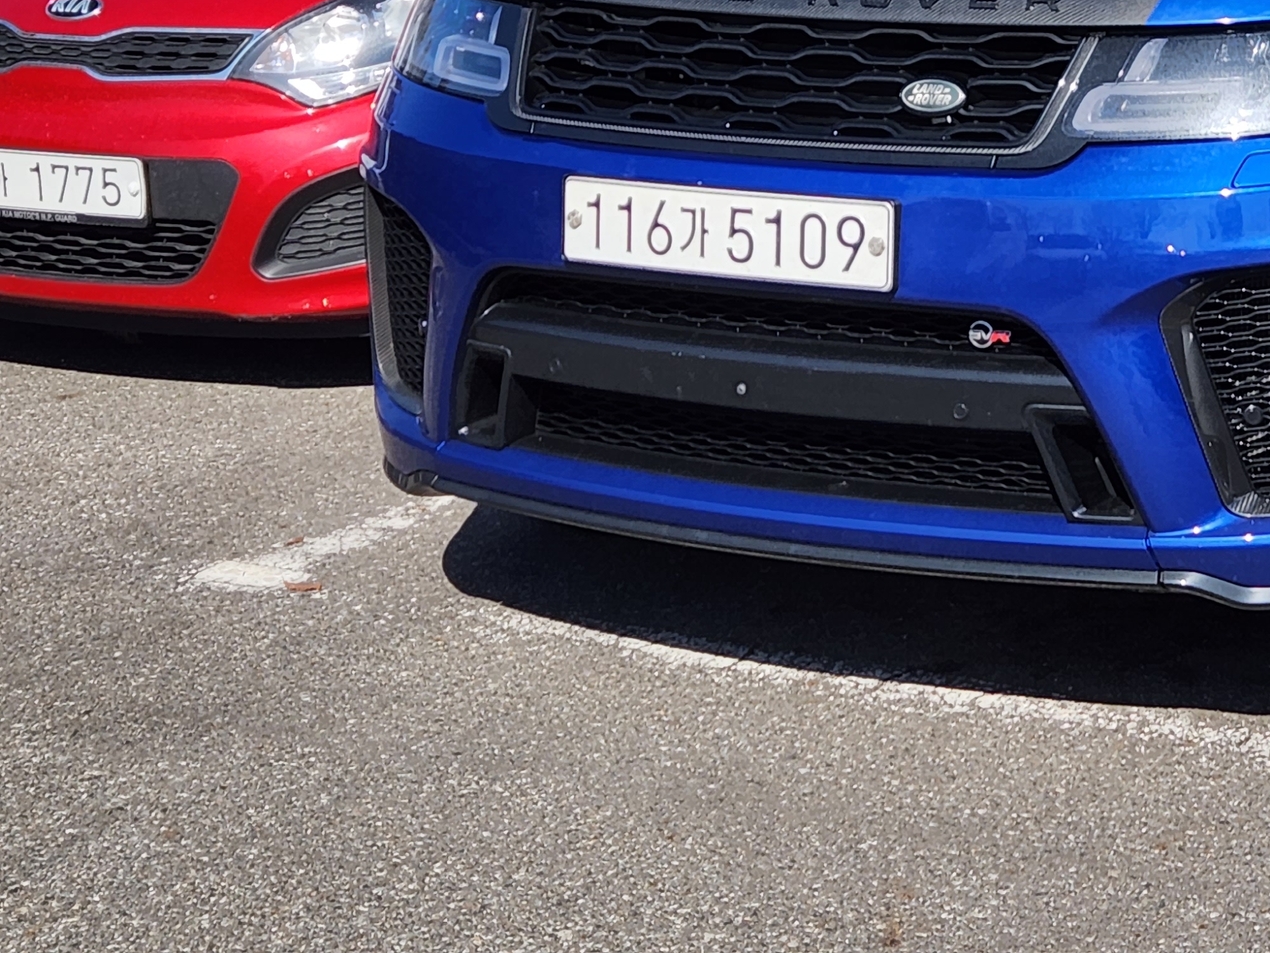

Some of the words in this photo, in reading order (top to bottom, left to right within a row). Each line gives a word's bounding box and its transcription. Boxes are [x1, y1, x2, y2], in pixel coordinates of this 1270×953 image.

[912, 83, 944, 95] LAND
[913, 93, 952, 106] ROVER
[29, 162, 121, 206] 1775
[586, 193, 709, 257] 116가
[726, 206, 866, 272] 5109
